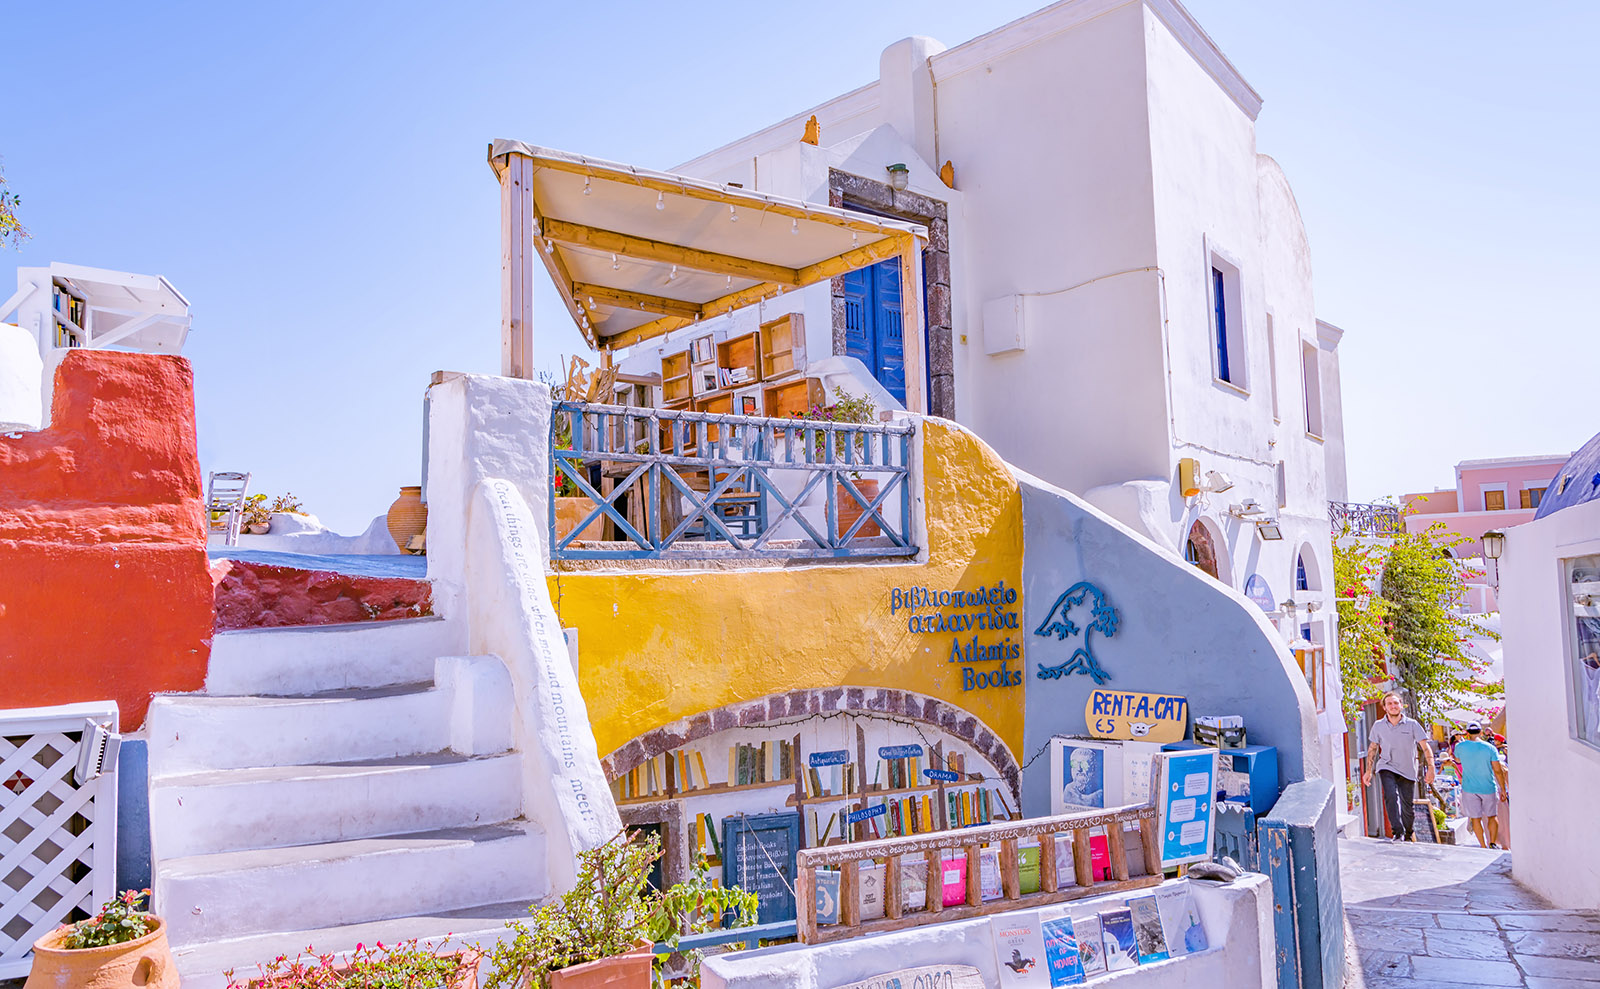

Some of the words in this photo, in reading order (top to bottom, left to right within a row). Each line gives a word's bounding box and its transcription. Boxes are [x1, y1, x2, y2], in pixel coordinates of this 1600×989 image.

[891, 581, 1018, 615] βιβλιοπωλείο
[908, 605, 1019, 634] ατλαντίδα
[506, 513, 523, 548] things
[531, 605, 547, 636] when
[539, 638, 553, 663] men
[551, 692, 578, 769] mountains
[948, 635, 1020, 663] Atlantis
[961, 661, 1022, 691] Books
[1092, 691, 1188, 722] RENT-A-CAT
[1095, 719, 1115, 734] €5
[928, 770, 953, 780] DRAMA
[848, 807, 883, 821] PHILOSOPHY
[806, 855, 824, 865] Our
[826, 849, 864, 863] handmade
[866, 846, 887, 858] books
[889, 841, 919, 855] designed
[928, 839, 937, 848] be
[937, 837, 953, 847] sent
[954, 836, 962, 848] by
[963, 834, 978, 843] mail
[1049, 823, 1056, 832] A
[999, 928, 1032, 938] MONSTERS
[1053, 955, 1079, 969] HOMER
